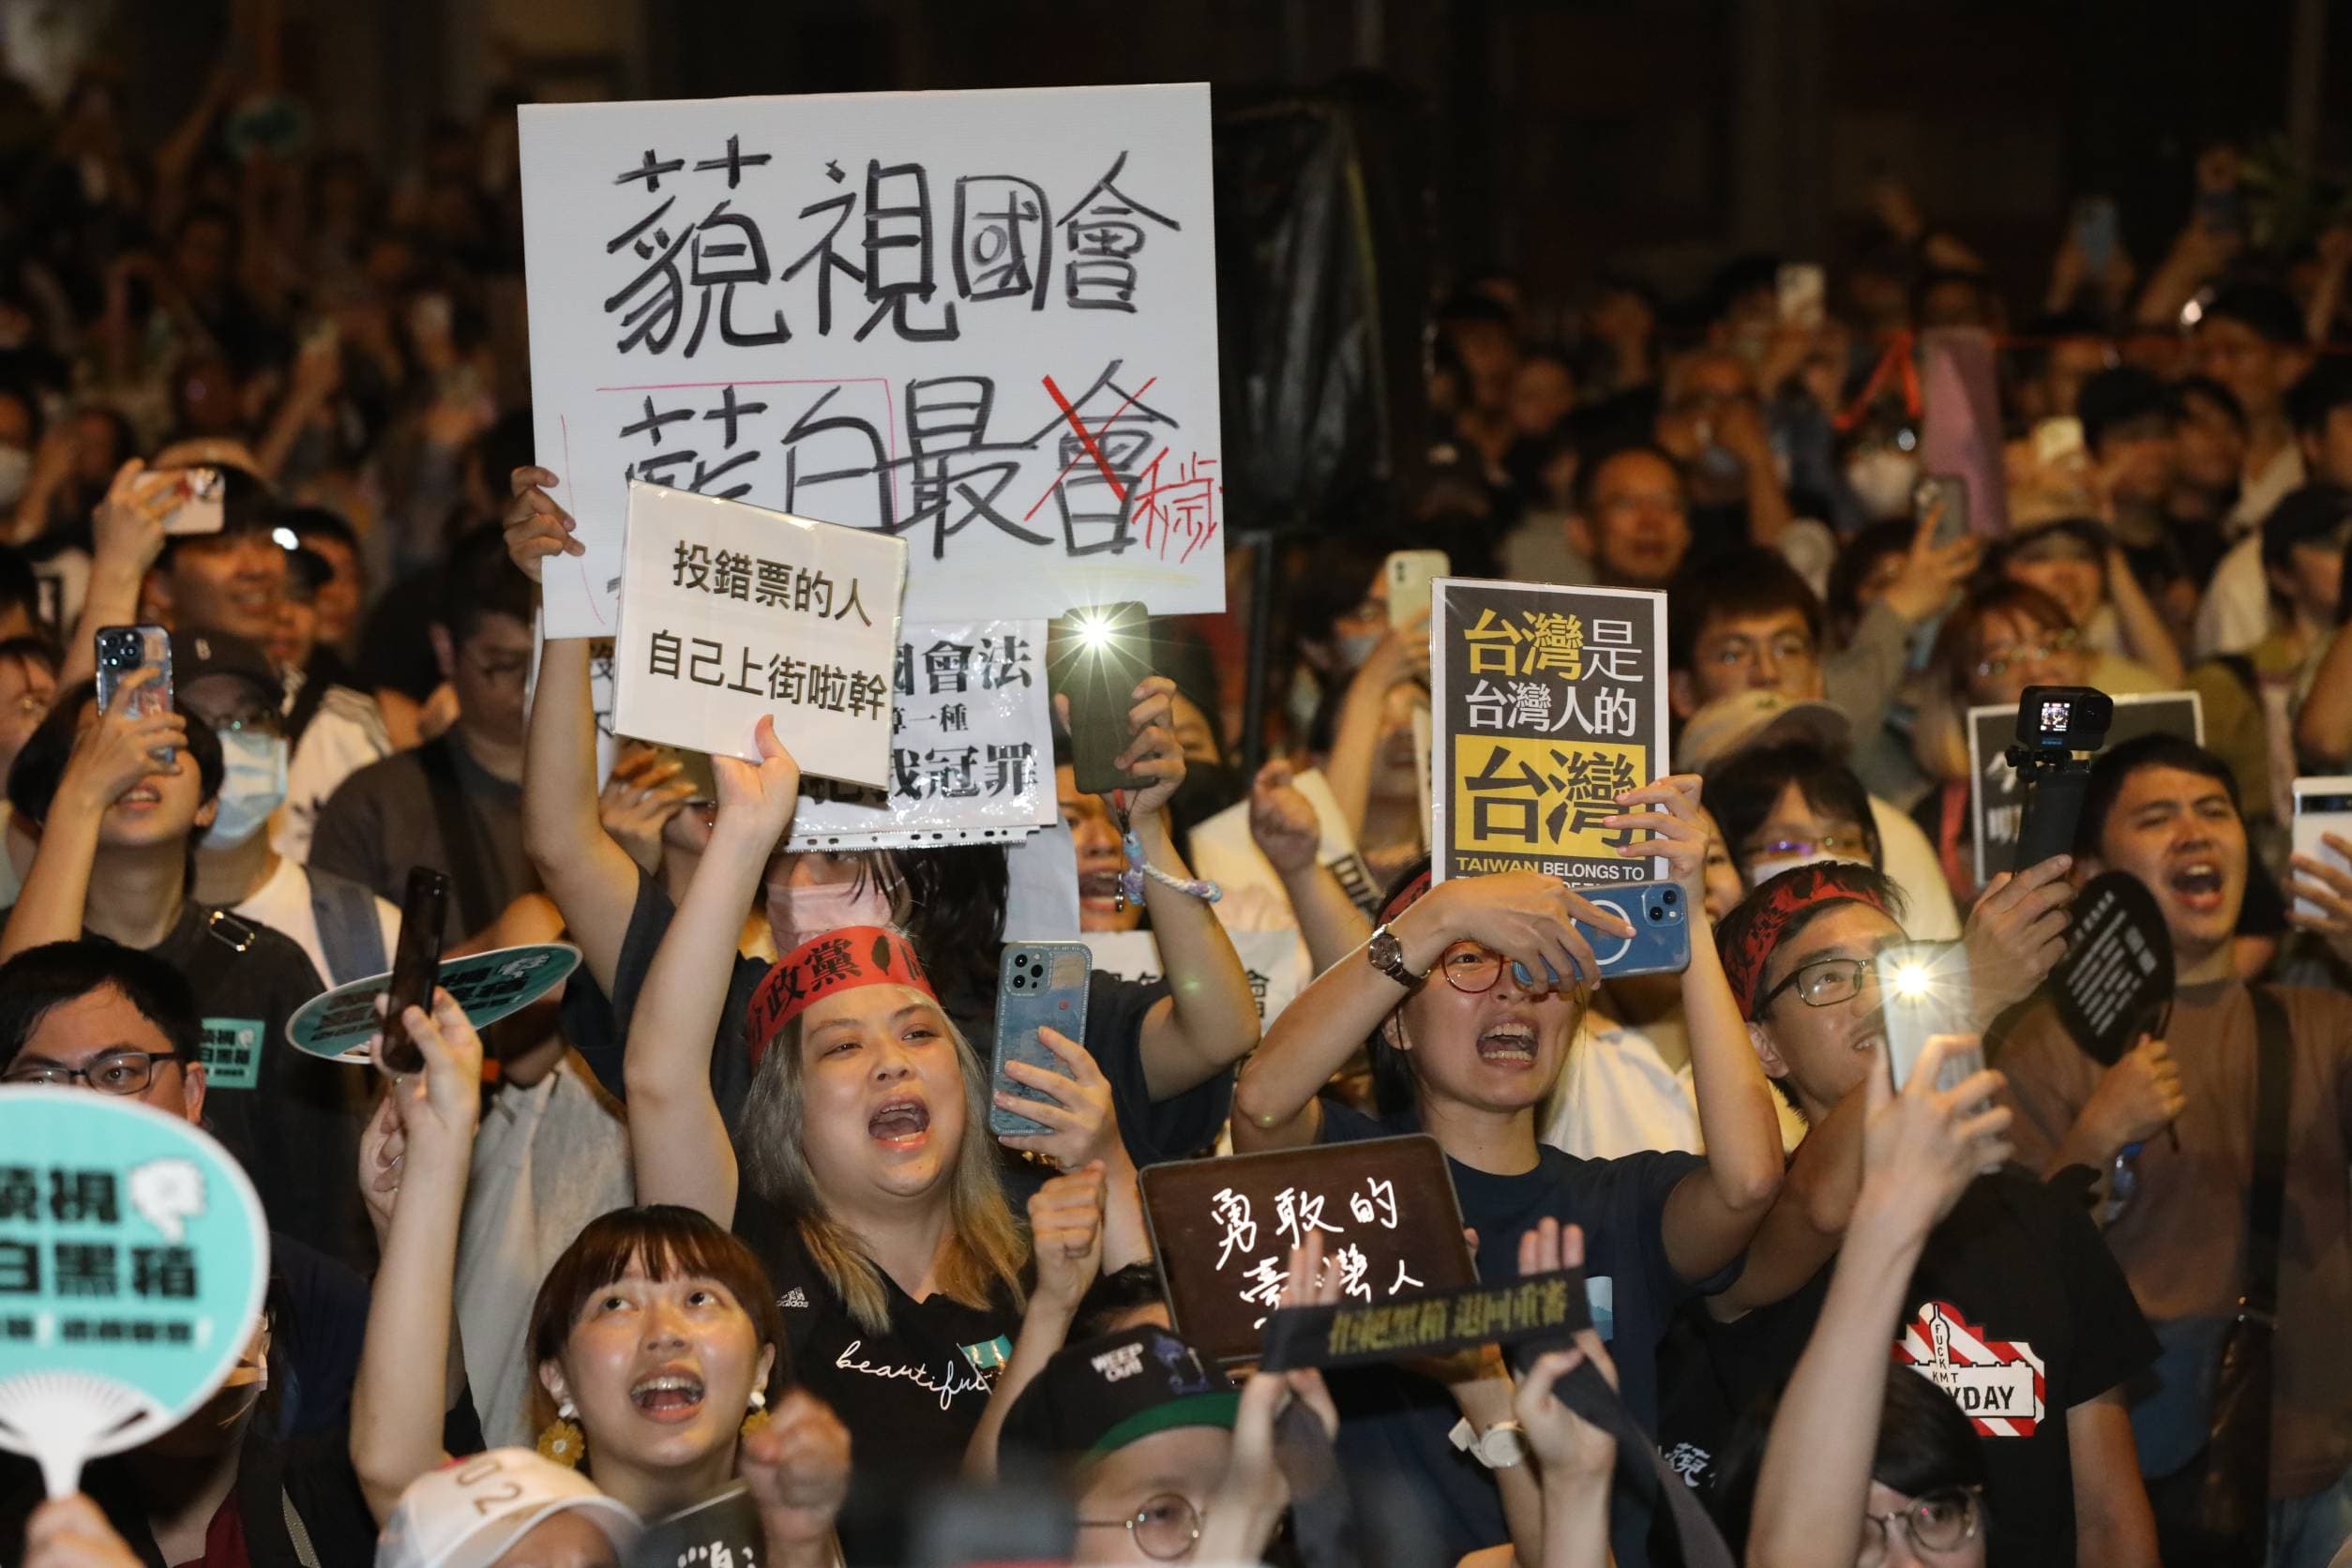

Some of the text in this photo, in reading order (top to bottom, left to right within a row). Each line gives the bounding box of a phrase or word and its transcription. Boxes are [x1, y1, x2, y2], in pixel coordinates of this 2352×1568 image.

[604, 134, 1182, 358] 藐視國會
[673, 539, 873, 627] 投錯票的人
[650, 629, 887, 720] 自己上街啦幹
[1464, 608, 1644, 683] 台灣是
[1465, 679, 1636, 737] 台灣人的
[1464, 745, 1636, 848] 台灣
[1455, 856, 1645, 881] TAIWAN BELONGS TO
[1211, 1177, 1397, 1271] 勇敢的
[1932, 1371, 1958, 1383] KMT
[1934, 1323, 1947, 1369] FUCK
